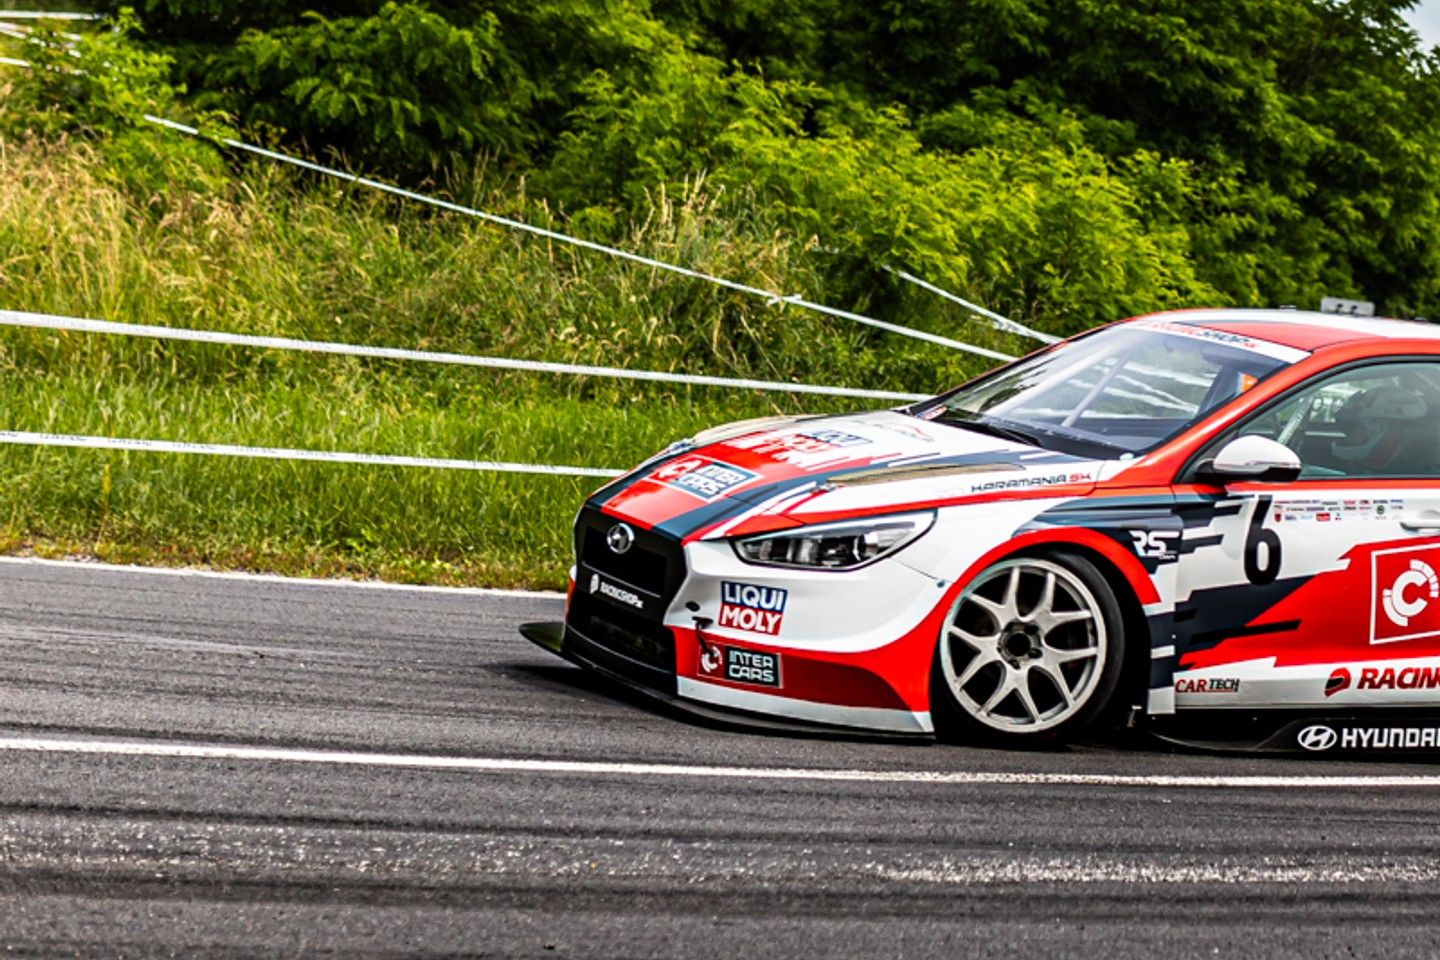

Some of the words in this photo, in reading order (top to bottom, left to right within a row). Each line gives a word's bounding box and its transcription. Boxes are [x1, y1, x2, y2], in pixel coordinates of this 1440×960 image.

[1128, 530, 1180, 557] RS
[1244, 495, 1282, 586] 6
[724, 583, 785, 611] LIQUI
[721, 605, 782, 633] MOLY
[728, 664, 775, 682] CARS
[729, 650, 774, 669] INTER
